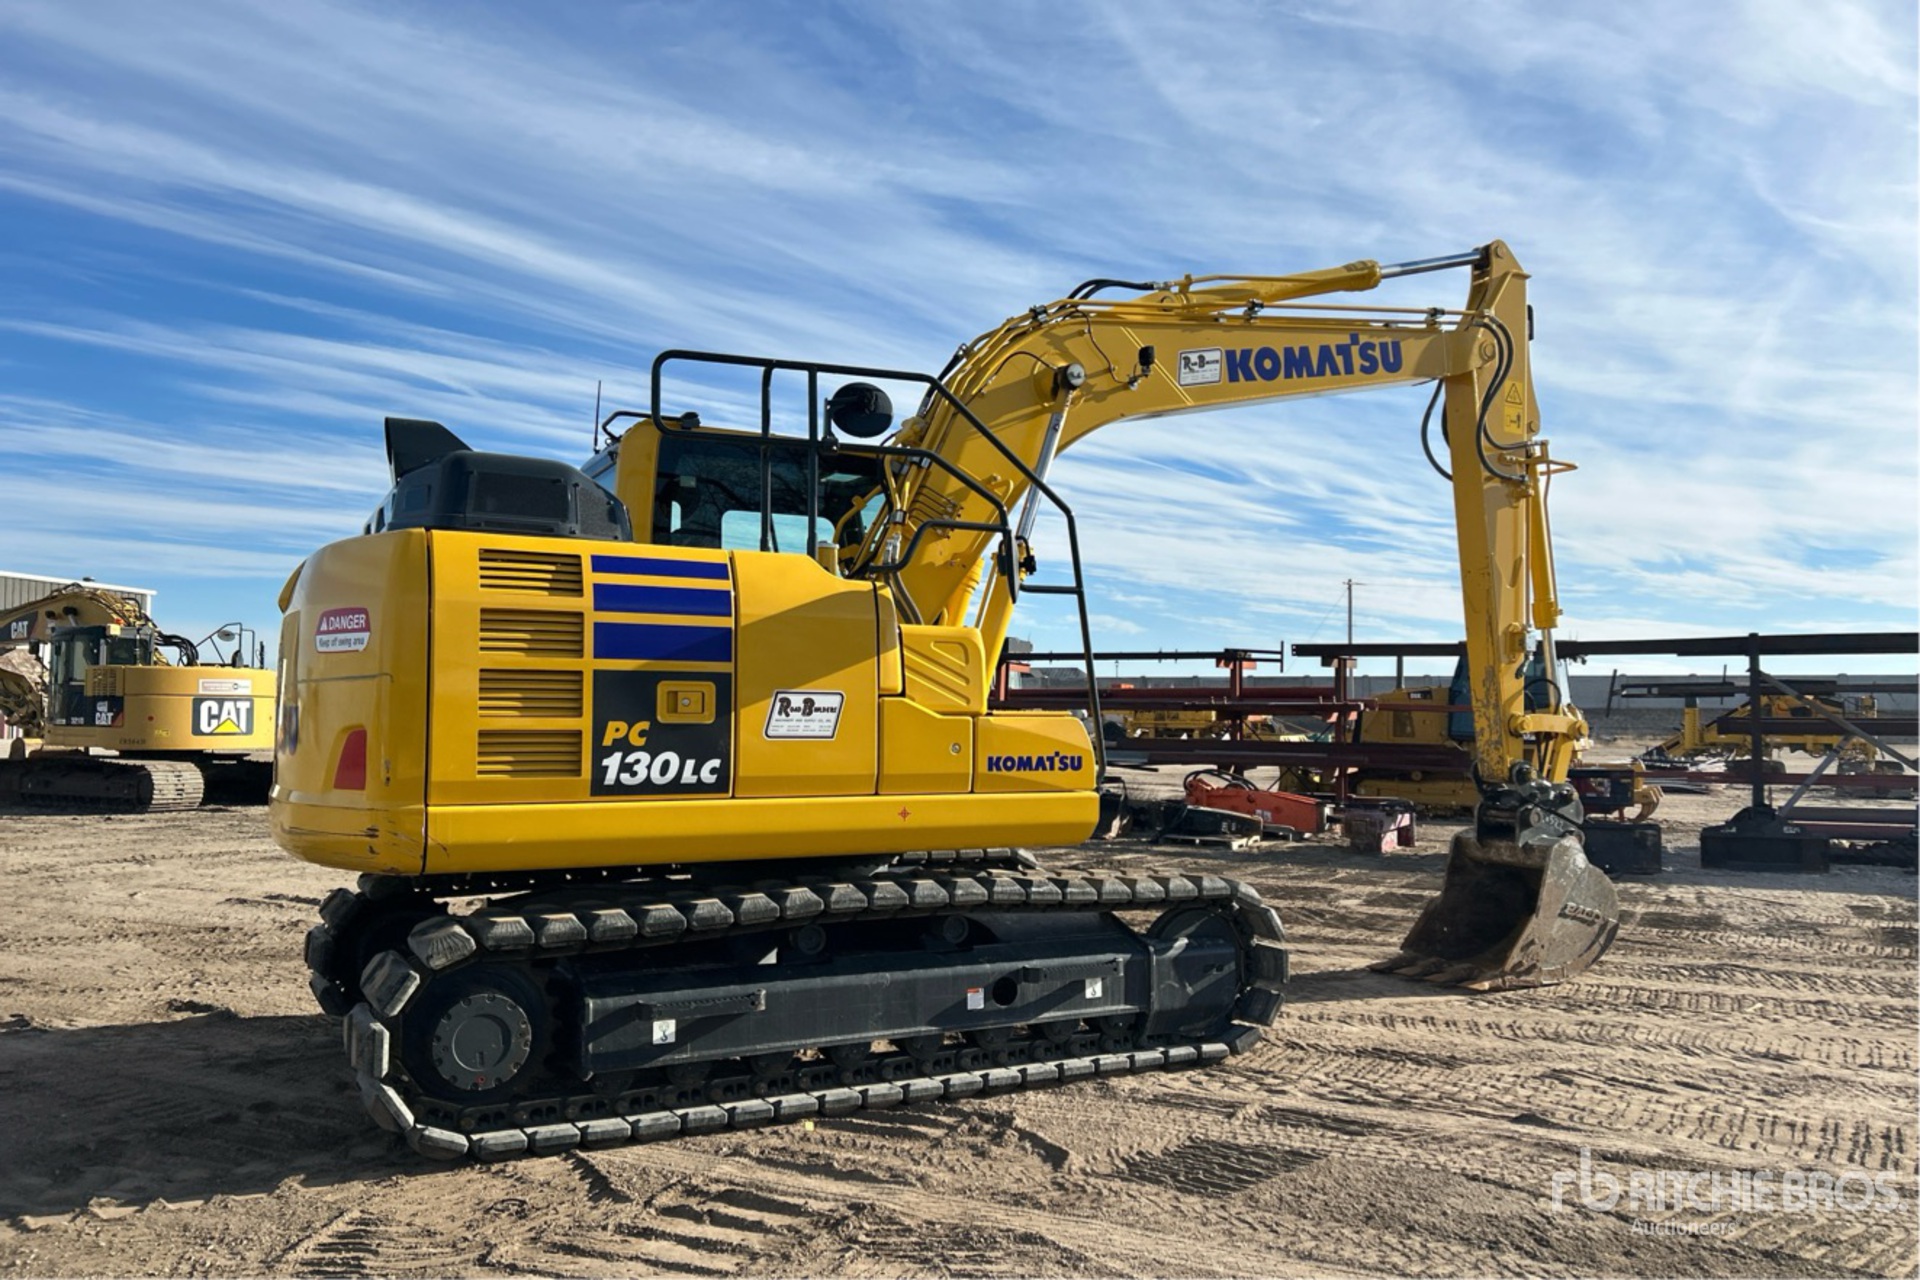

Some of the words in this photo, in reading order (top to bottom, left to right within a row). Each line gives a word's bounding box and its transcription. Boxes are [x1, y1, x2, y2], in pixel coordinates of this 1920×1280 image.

[1225, 333, 1403, 383] KOMATSU
[11, 621, 28, 639] CAT
[328, 614, 366, 631] DANGER
[95, 711, 114, 725] CAT
[200, 700, 250, 734] CAT
[602, 720, 650, 747] PC
[987, 751, 1082, 772] KOMATSU
